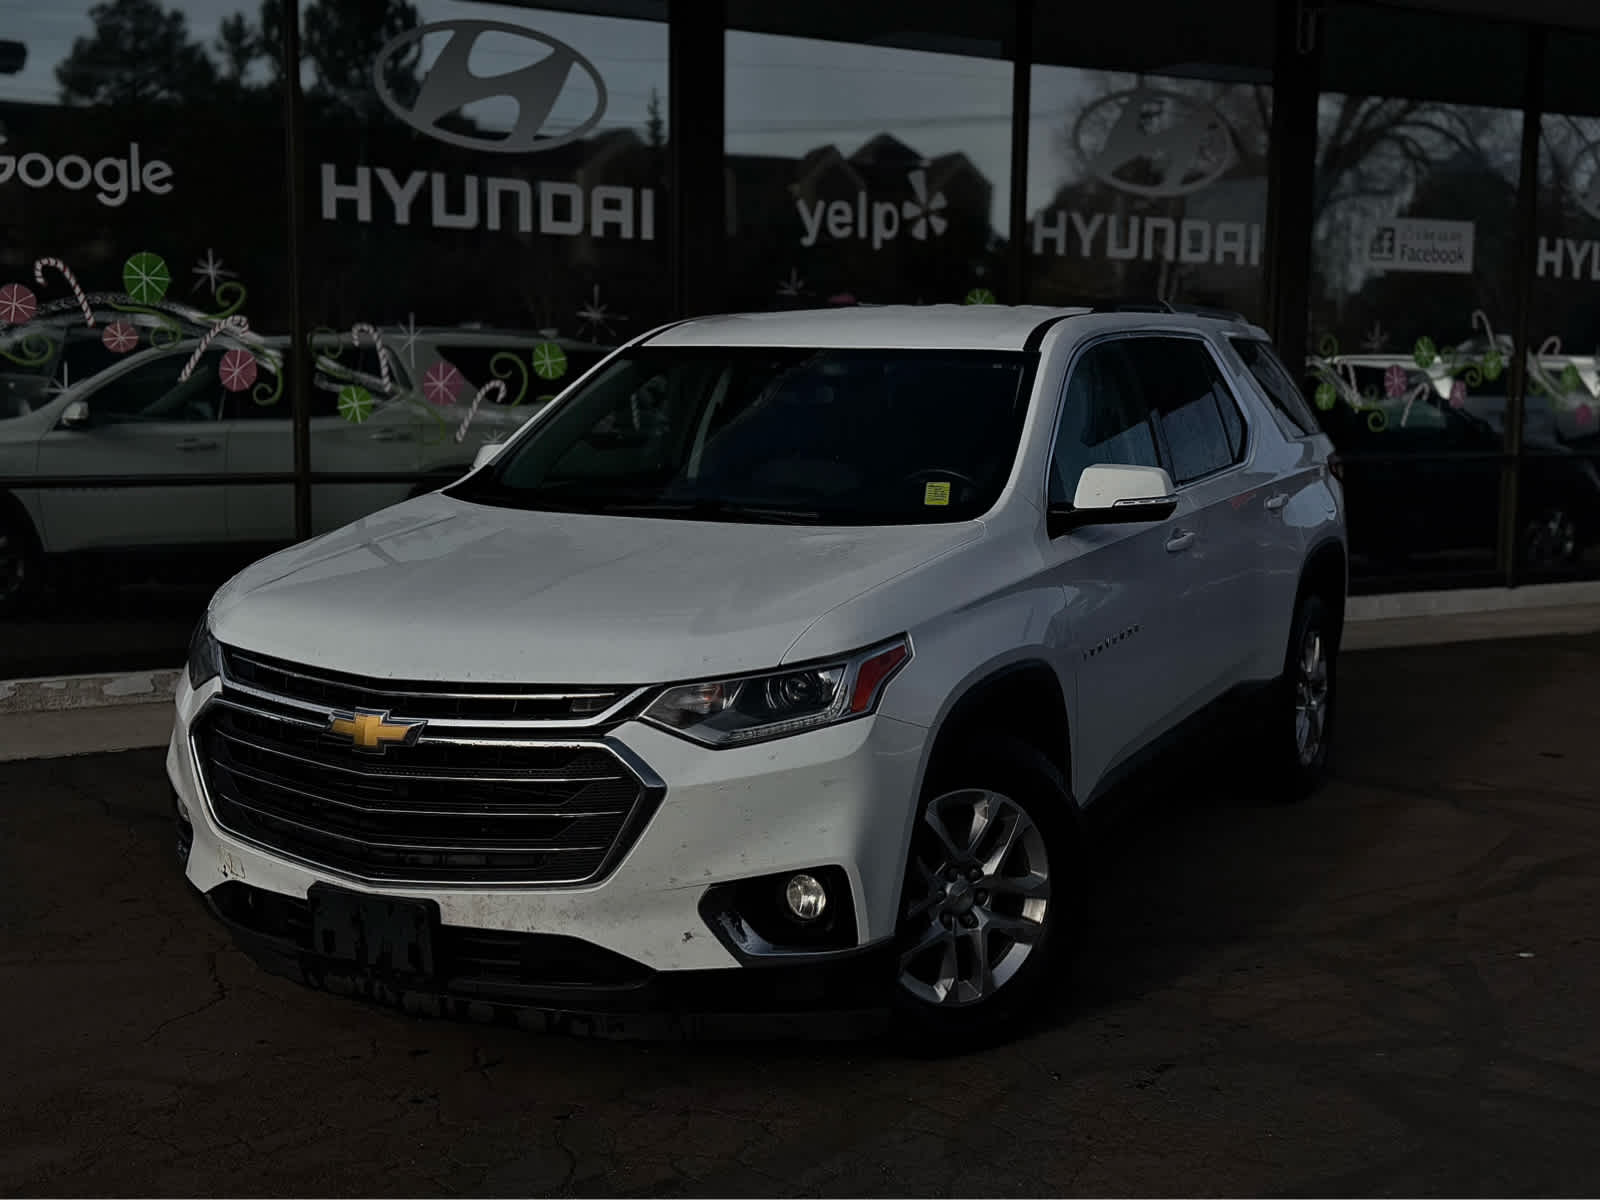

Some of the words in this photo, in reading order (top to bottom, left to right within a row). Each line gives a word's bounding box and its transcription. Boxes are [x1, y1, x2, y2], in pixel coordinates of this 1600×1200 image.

[320, 161, 656, 241] HYUNDAI
[796, 189, 900, 250] yelp
[1032, 210, 1261, 266] HYUNDAI
[1399, 242, 1465, 265] Facebook
[1537, 235, 1600, 282] HY
